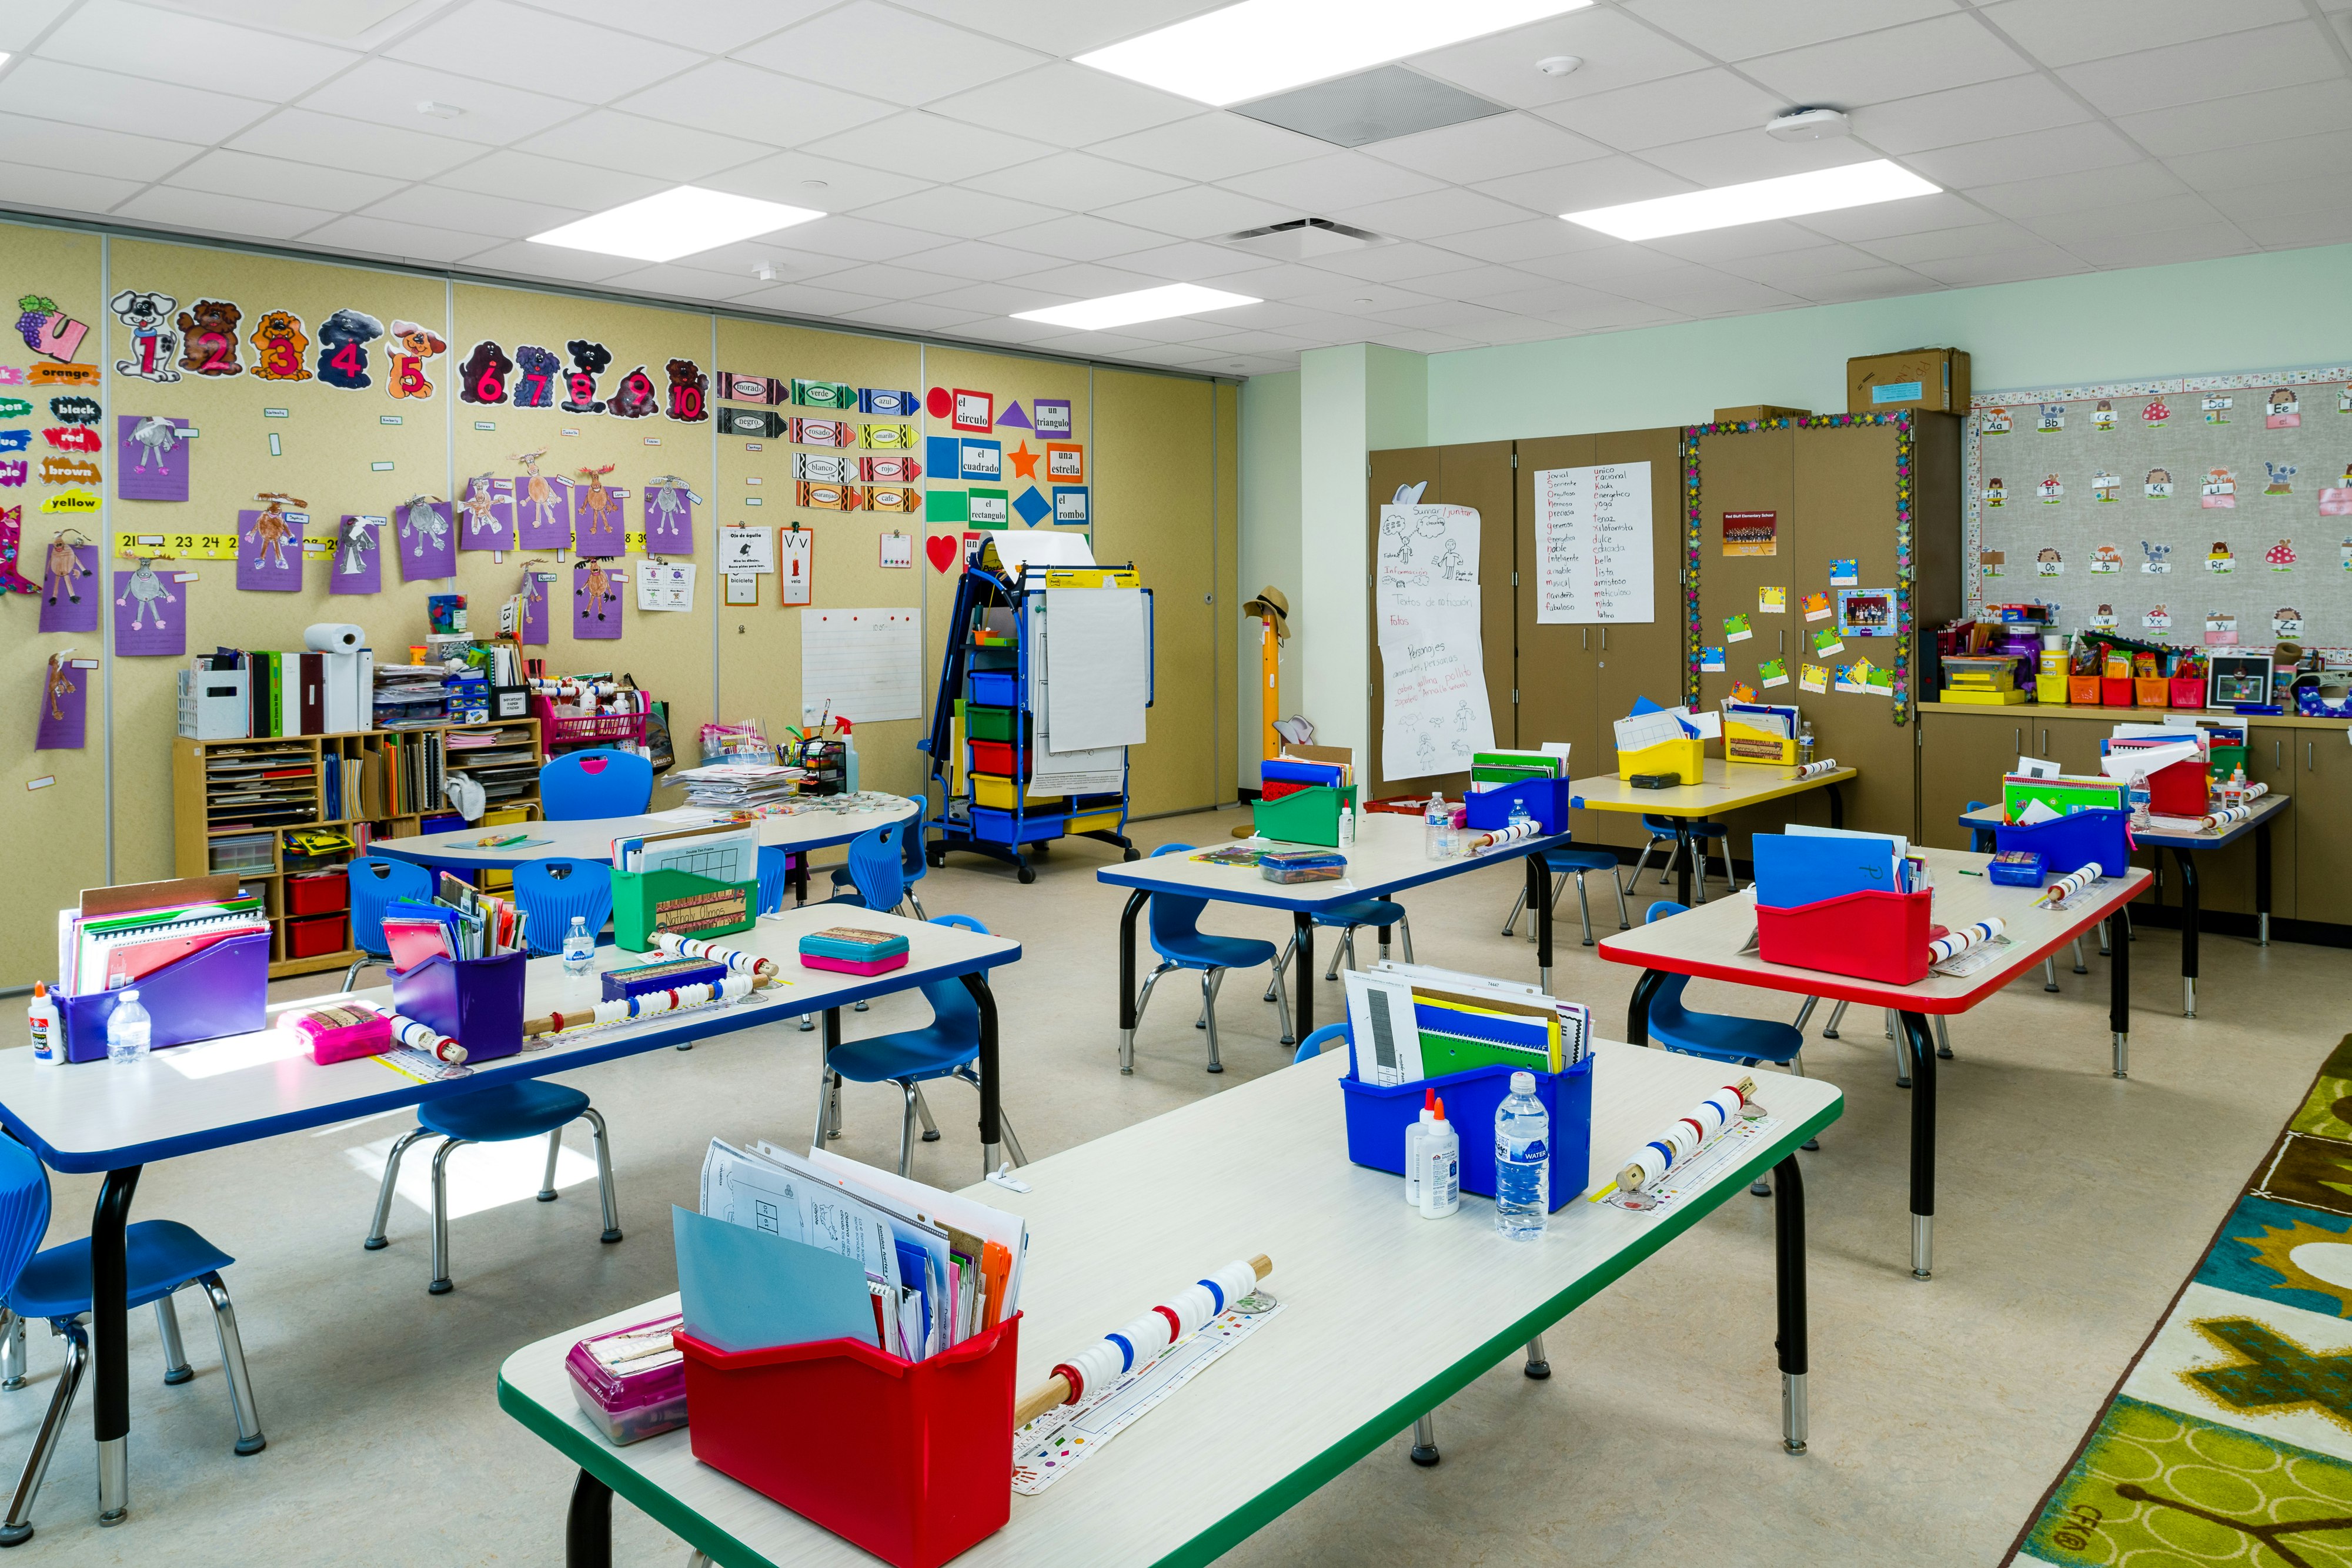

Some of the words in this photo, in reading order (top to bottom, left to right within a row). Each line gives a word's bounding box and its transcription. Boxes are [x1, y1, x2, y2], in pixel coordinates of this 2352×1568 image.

[140, 336, 158, 374] 1
[198, 332, 230, 370] 2
[269, 338, 295, 376] 3
[331, 343, 362, 377] 4
[42, 369, 89, 379] orange
[401, 357, 425, 392] 5
[477, 368, 503, 402] 6
[527, 373, 547, 406] 7
[571, 373, 592, 404] 8
[629, 375, 650, 405] 9
[737, 383, 764, 392] morado
[811, 389, 828, 397] verde
[674, 386, 701, 415] 10
[958, 398, 965, 407] el
[2209, 399, 2225, 409] Dd
[59, 404, 95, 414] black
[2274, 403, 2288, 413] Ee
[739, 418, 759, 427] negro
[2097, 413, 2110, 422] Cc
[1989, 421, 2002, 430] Aa
[2044, 419, 2058, 428] Bb
[809, 428, 830, 436] rosado
[61, 433, 84, 443] red
[978, 450, 984, 458] el
[49, 465, 92, 476] brown
[811, 463, 833, 472] blanco
[963, 462, 998, 473] cuadrado
[1051, 464, 1080, 474] estrella
[1547, 471, 1568, 480] jovial
[1595, 471, 1626, 481] racional
[2046, 487, 2054, 496] Ii
[2153, 484, 2164, 493] Kk
[813, 492, 840, 500] anaranjado
[1059, 495, 1065, 504] el
[1986, 490, 2002, 499] Hh
[52, 499, 95, 508] yellow
[1548, 499, 1572, 507] hermosa
[1594, 501, 1612, 510] yoga
[1059, 510, 1084, 519] rombo
[1413, 506, 1441, 515] Sumar
[1548, 510, 1574, 521] preciosa
[1592, 514, 1616, 523] tenaz
[1547, 522, 1573, 535] generosa
[1592, 523, 1633, 532] xilofonista
[122, 535, 136, 547] 21
[175, 536, 193, 548] 23
[202, 537, 219, 549] 24
[966, 540, 977, 548] un
[1592, 534, 1612, 544] dulce
[1547, 545, 1566, 553] noble
[1592, 544, 1625, 553] educada
[1548, 554, 1579, 566] inteligente
[1594, 555, 1611, 565] bella
[2211, 560, 2223, 569] Rr
[1384, 565, 1428, 576] Información
[1595, 566, 1614, 577] lista
[2045, 563, 2055, 571] Oo
[2102, 562, 2110, 571] Pp
[2149, 563, 2163, 573] Qq
[1546, 577, 1571, 589] musical
[1594, 578, 1626, 586] amistoso
[1546, 591, 1574, 599] navideño
[1594, 589, 1631, 597] meticuloso
[1392, 594, 1421, 607] Textos
[1425, 596, 1435, 607] de
[1545, 601, 1575, 611] fabuloso
[503, 606, 511, 621] 13
[1597, 610, 1615, 618] latina
[1390, 615, 1409, 626] Fotos
[2094, 616, 2109, 625] Ww
[2149, 617, 2162, 626] Xx
[2280, 620, 2297, 630] Zz
[2216, 621, 2229, 631] Yy
[1408, 643, 1445, 660] Personajes
[1392, 664, 1423, 678] animales,
[1424, 654, 1458, 670] personas
[1417, 676, 1438, 692] gallina
[1445, 664, 1472, 686] pollito
[1394, 693, 1418, 708] zapatero
[653, 757, 671, 765] CARGO
[666, 908, 695, 926] Nathaly
[700, 905, 725, 919] Olmos
[1525, 1150, 1546, 1159] WATER
[763, 1205, 768, 1214] 20
[764, 1219, 769, 1227] 19
